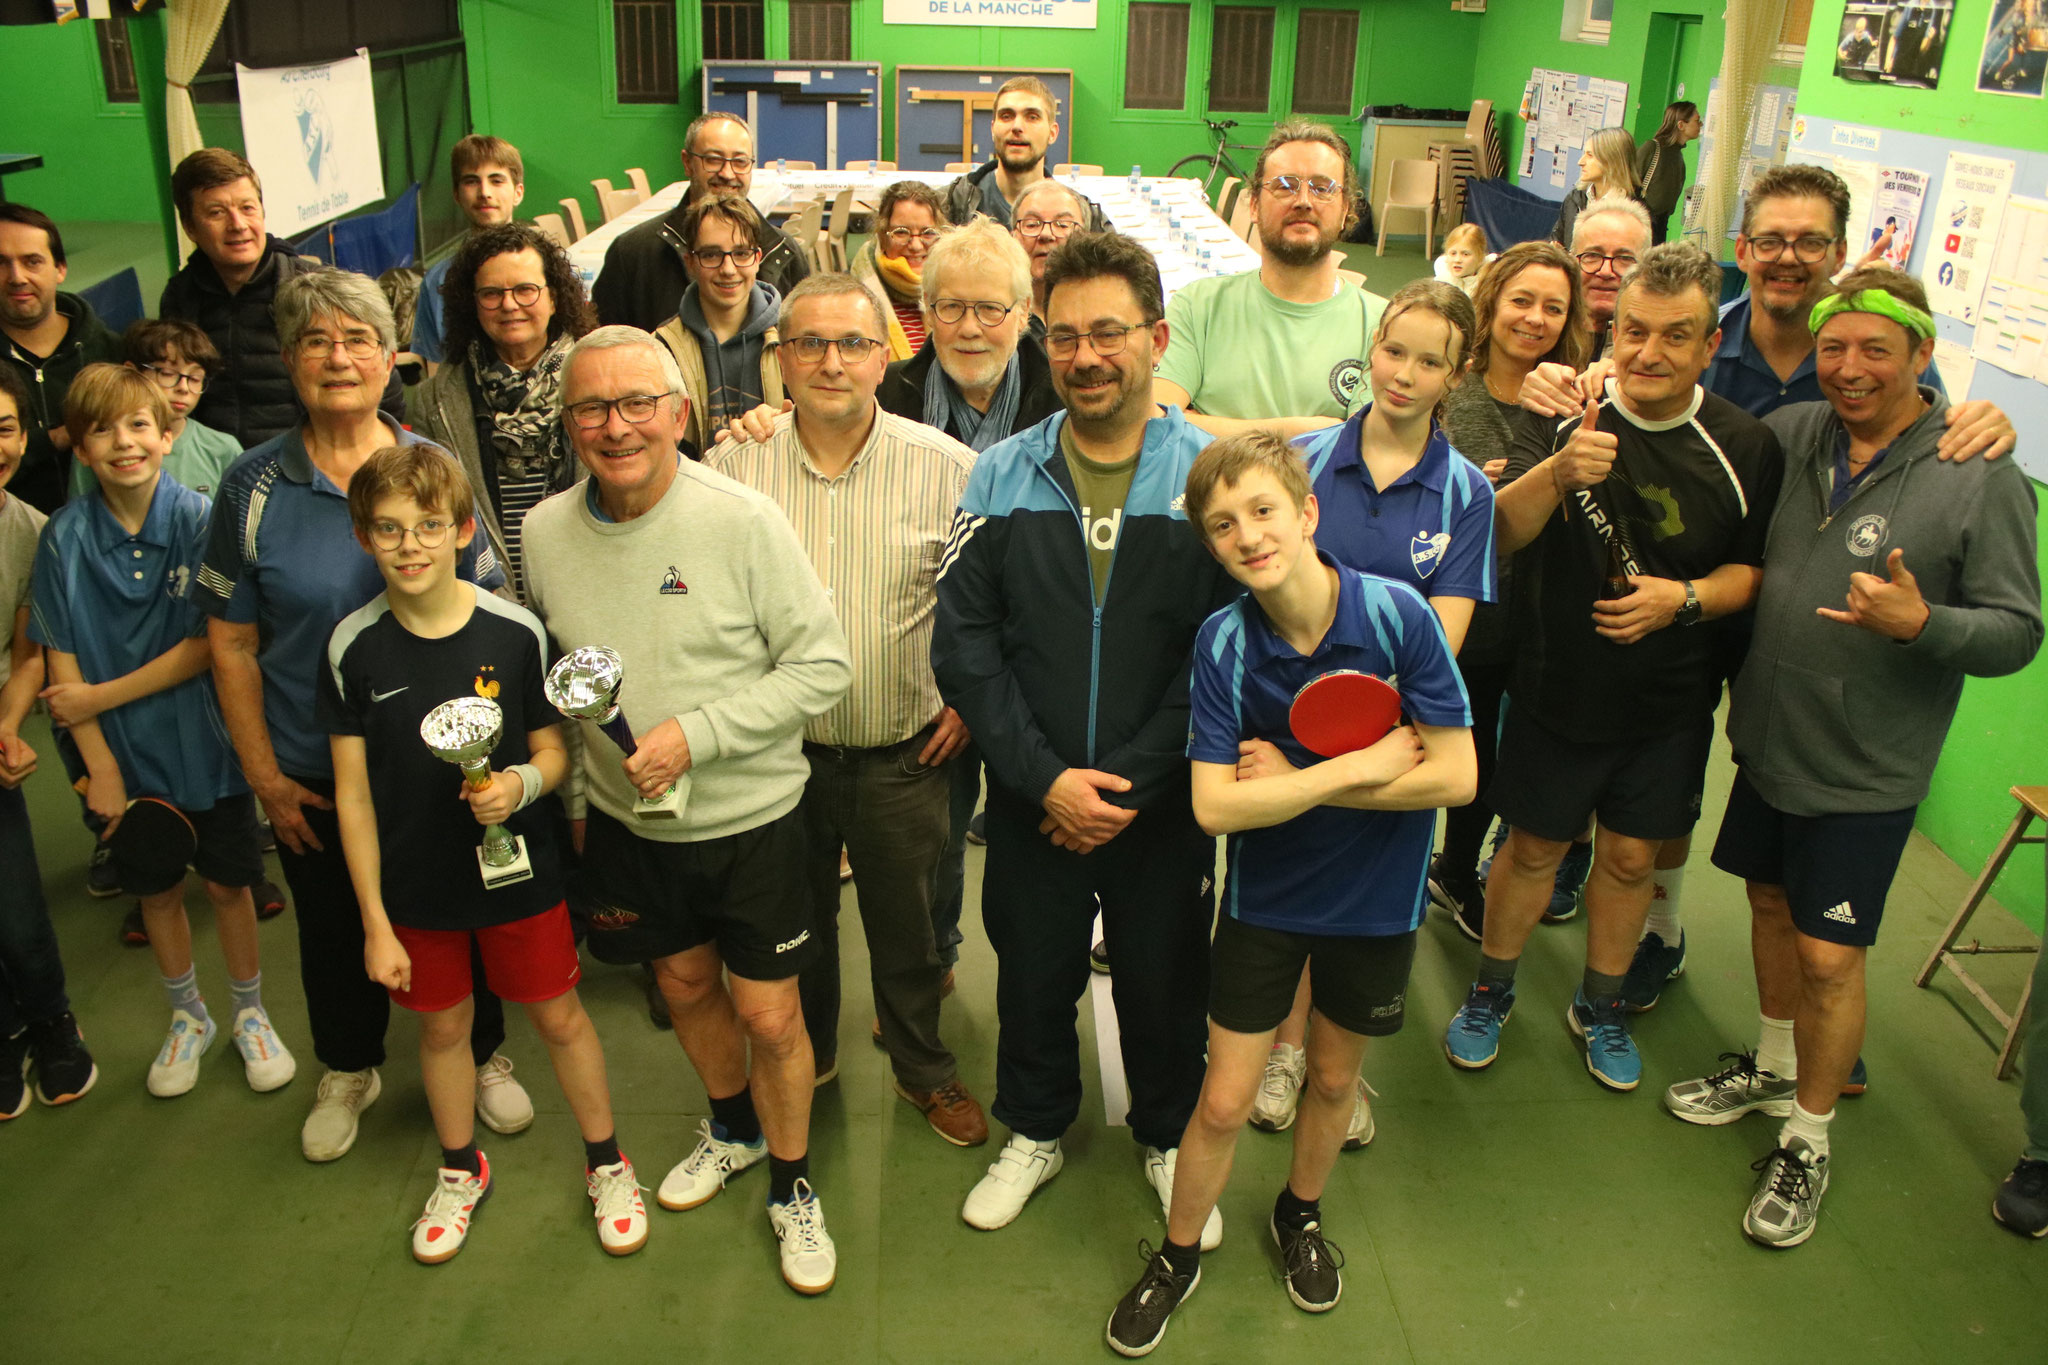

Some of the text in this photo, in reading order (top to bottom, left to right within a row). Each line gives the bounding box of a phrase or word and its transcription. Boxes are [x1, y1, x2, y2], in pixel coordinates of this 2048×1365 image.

[929, 1, 1053, 15] DE LA MANCHE
[297, 189, 349, 221] Tennis de Table
[1823, 911, 1856, 925] adidas
[776, 929, 809, 954] DONIC
